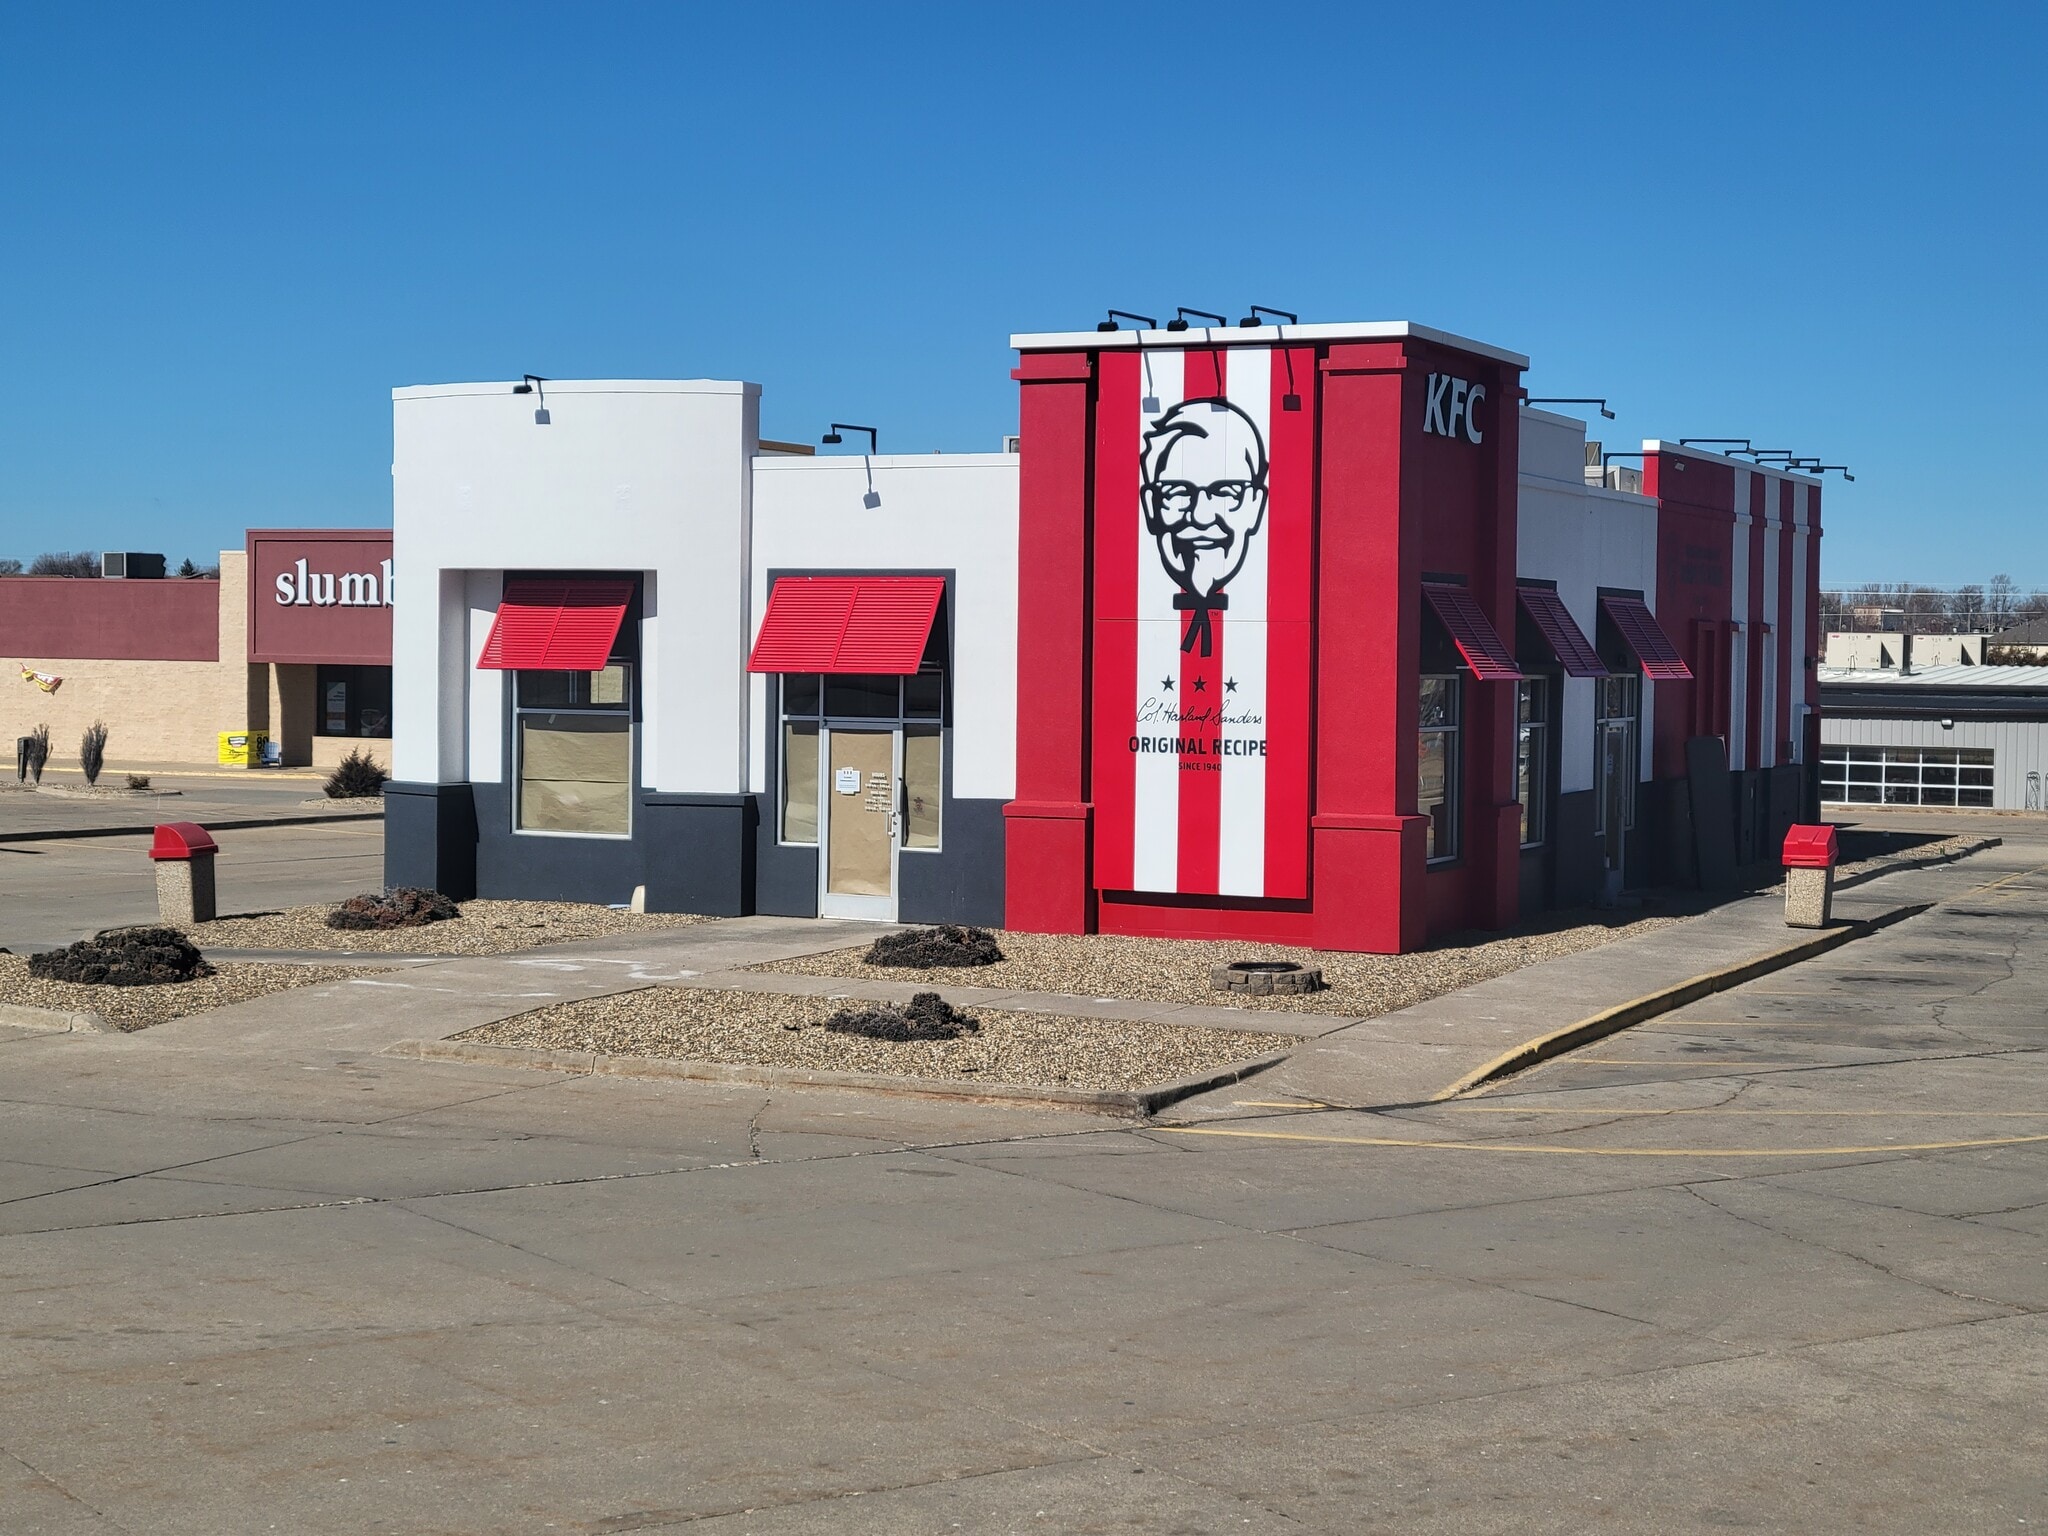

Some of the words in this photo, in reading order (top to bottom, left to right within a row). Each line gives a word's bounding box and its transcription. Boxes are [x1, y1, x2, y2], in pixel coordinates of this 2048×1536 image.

[1423, 372, 1487, 444] KFC
[1162, 702, 1213, 732] Harland
[1210, 699, 1262, 726] Sanders
[1129, 736, 1207, 755] ORIGINAL
[1212, 739, 1268, 756] RECIPE
[1178, 762, 1201, 771] SINCE
[1203, 763, 1222, 772] 1940
